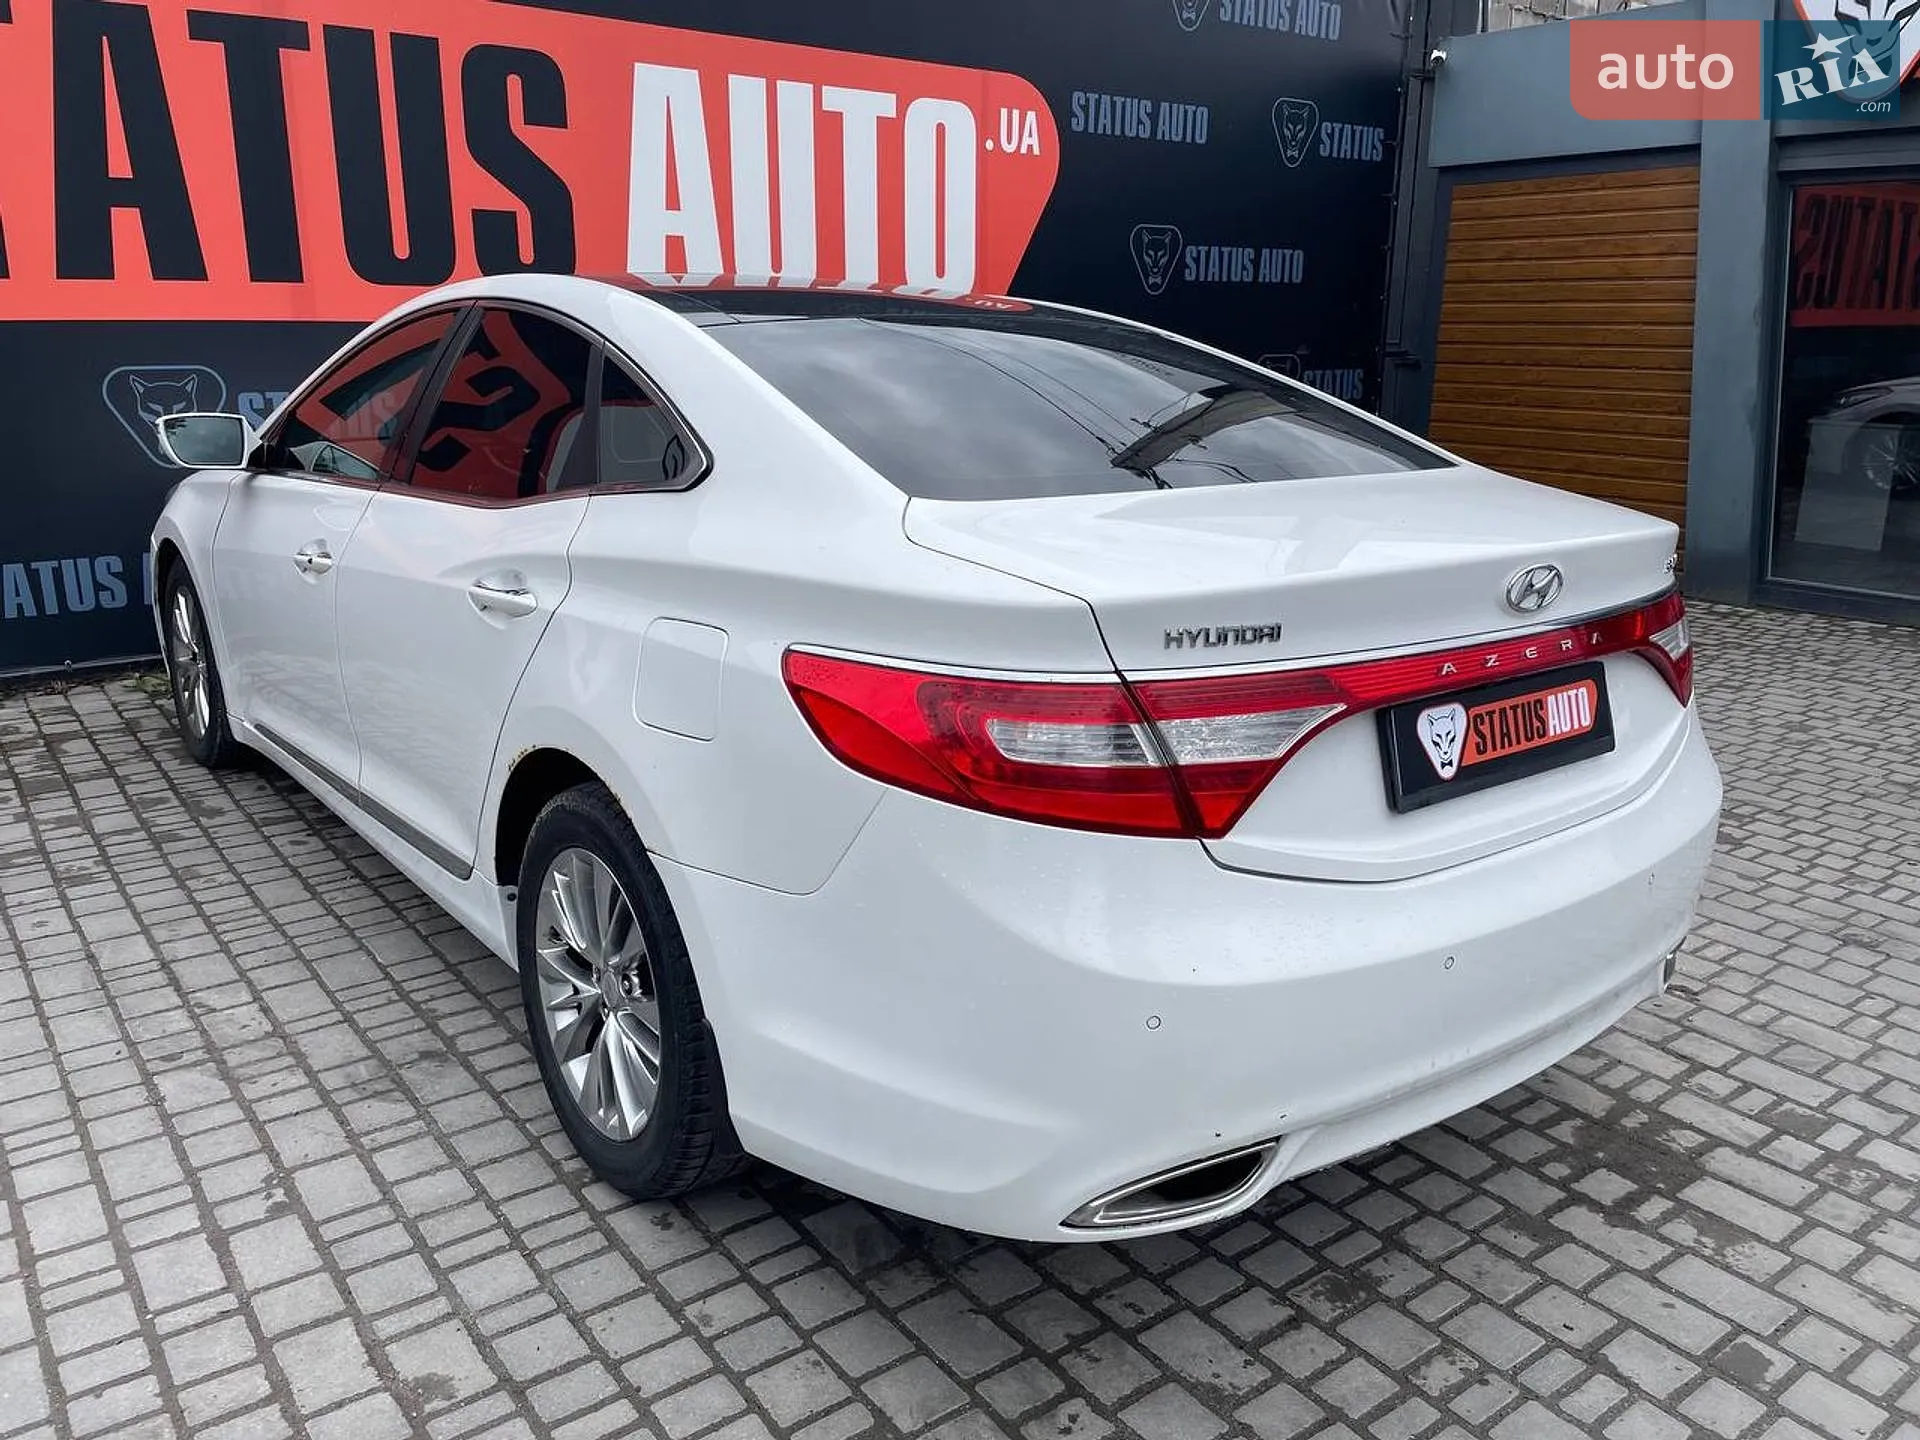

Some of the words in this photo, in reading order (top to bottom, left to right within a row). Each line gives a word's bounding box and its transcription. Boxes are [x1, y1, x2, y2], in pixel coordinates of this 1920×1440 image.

[1220, 0, 1290, 31] STATUS
[1295, 0, 1341, 40] AUTO
[1071, 91, 1153, 139] STATUS
[1156, 102, 1209, 144] AUTO
[0, 0, 577, 284] ATUS
[1319, 121, 1385, 162] STATUS
[1184, 246, 1255, 283] STATUS
[1258, 248, 1305, 283] AUTO
[1163, 622, 1281, 650] HYUNDAI
